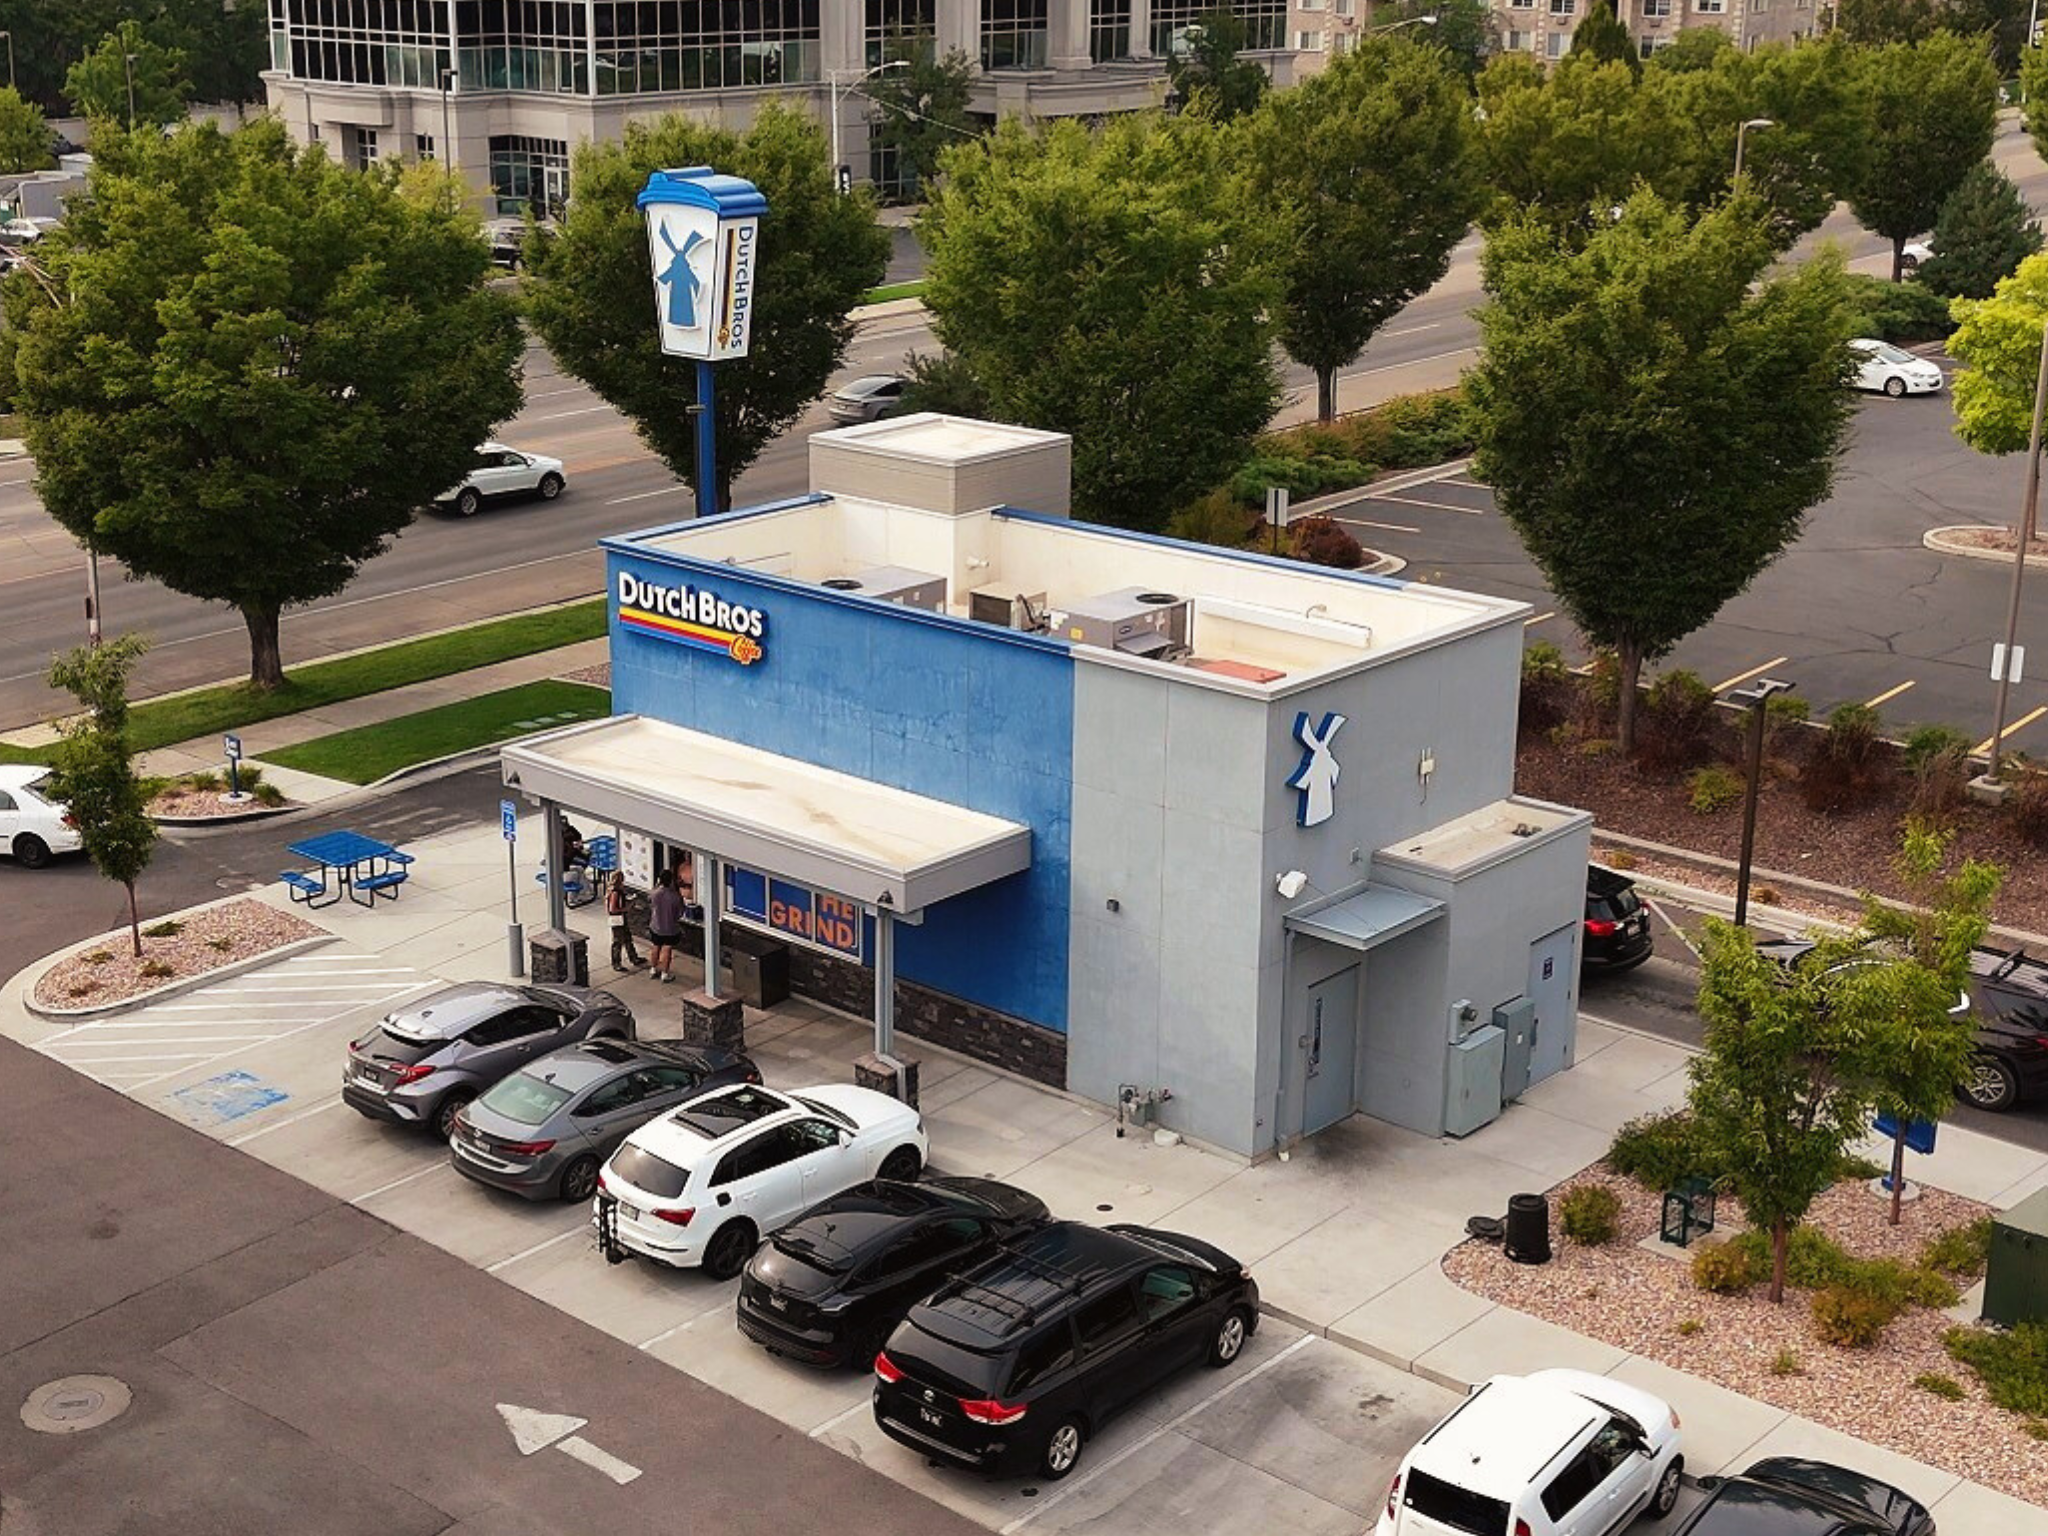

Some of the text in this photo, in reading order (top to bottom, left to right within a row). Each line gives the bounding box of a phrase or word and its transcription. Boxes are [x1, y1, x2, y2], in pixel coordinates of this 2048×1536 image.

[731, 297, 748, 349] BROS
[699, 591, 763, 637] BROS
[771, 901, 854, 948] GRIND
